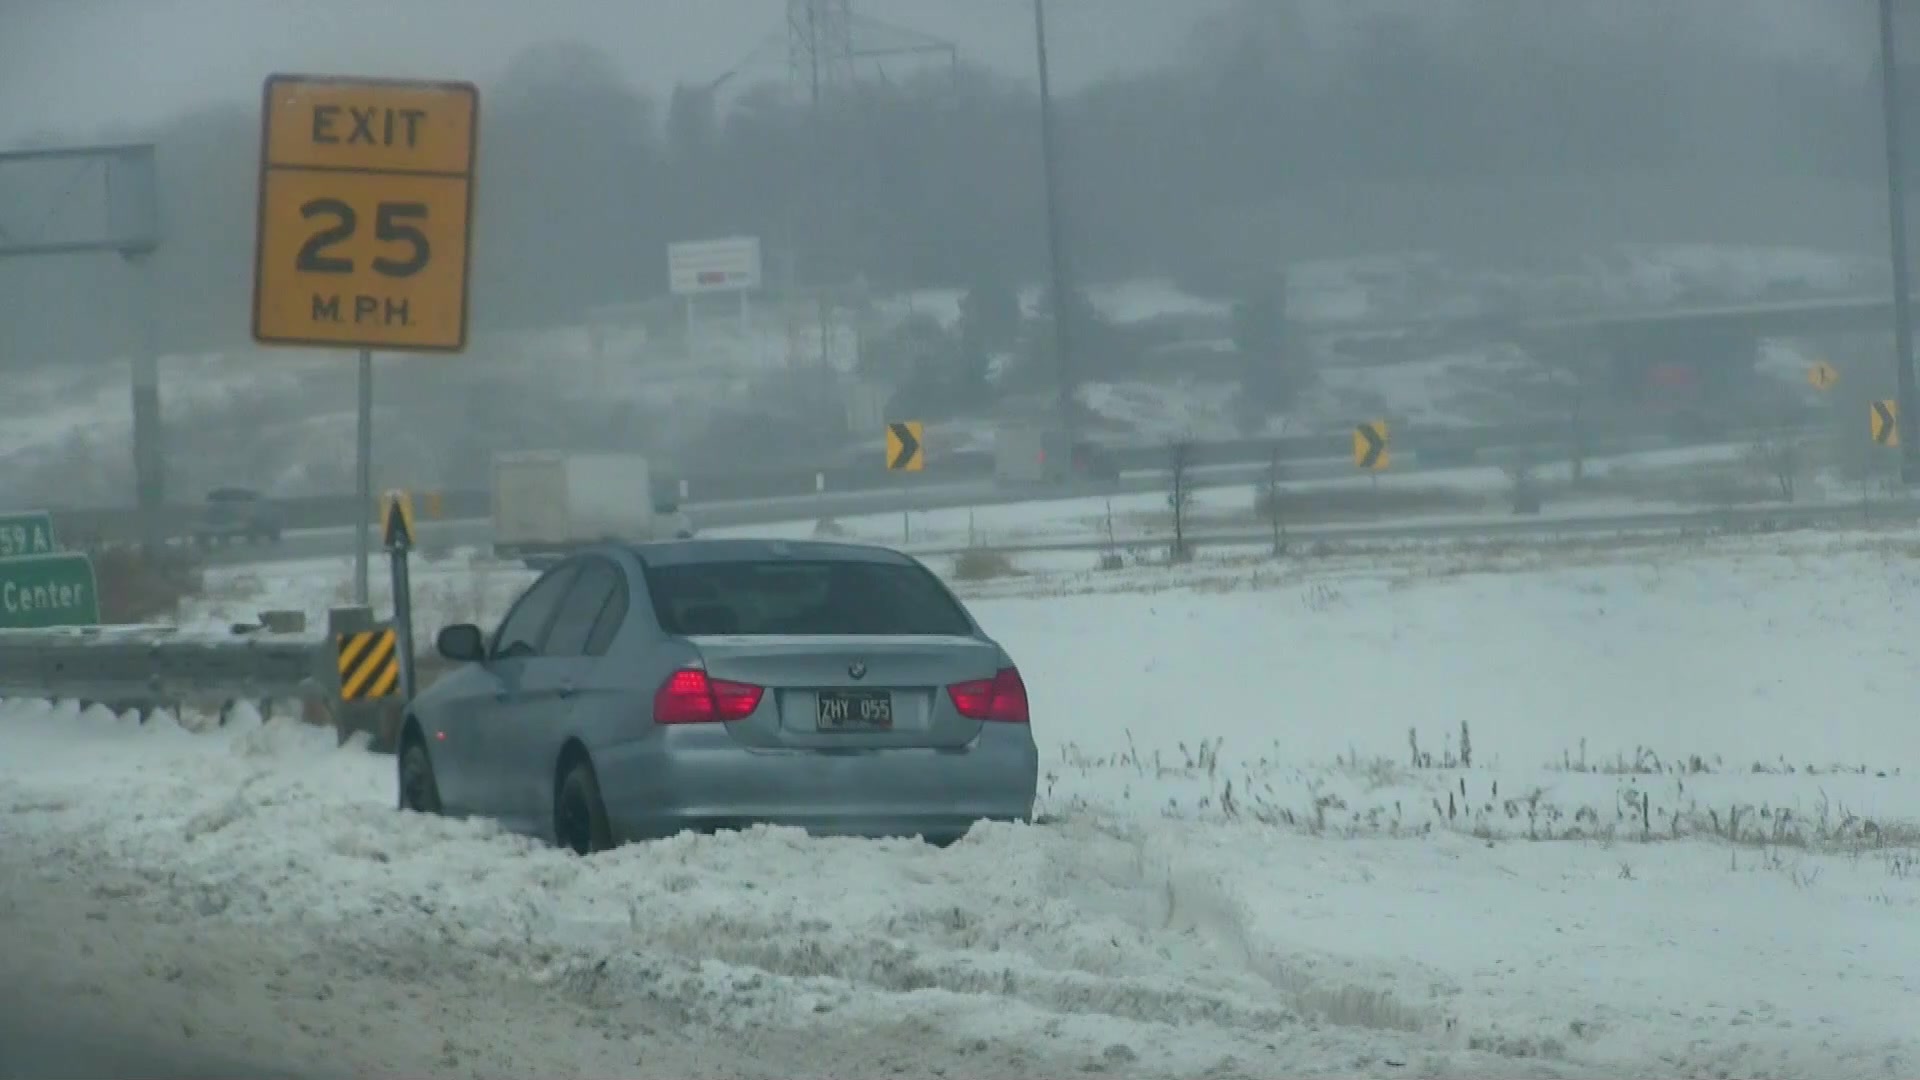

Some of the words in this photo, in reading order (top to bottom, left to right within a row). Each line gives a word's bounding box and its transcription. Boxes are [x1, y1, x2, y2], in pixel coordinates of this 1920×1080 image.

[313, 104, 427, 147] EXIT
[296, 197, 431, 278] 25
[34, 524, 49, 551] A
[4, 580, 83, 613] Center
[820, 699, 849, 720] ZHY
[861, 699, 889, 719] 055
